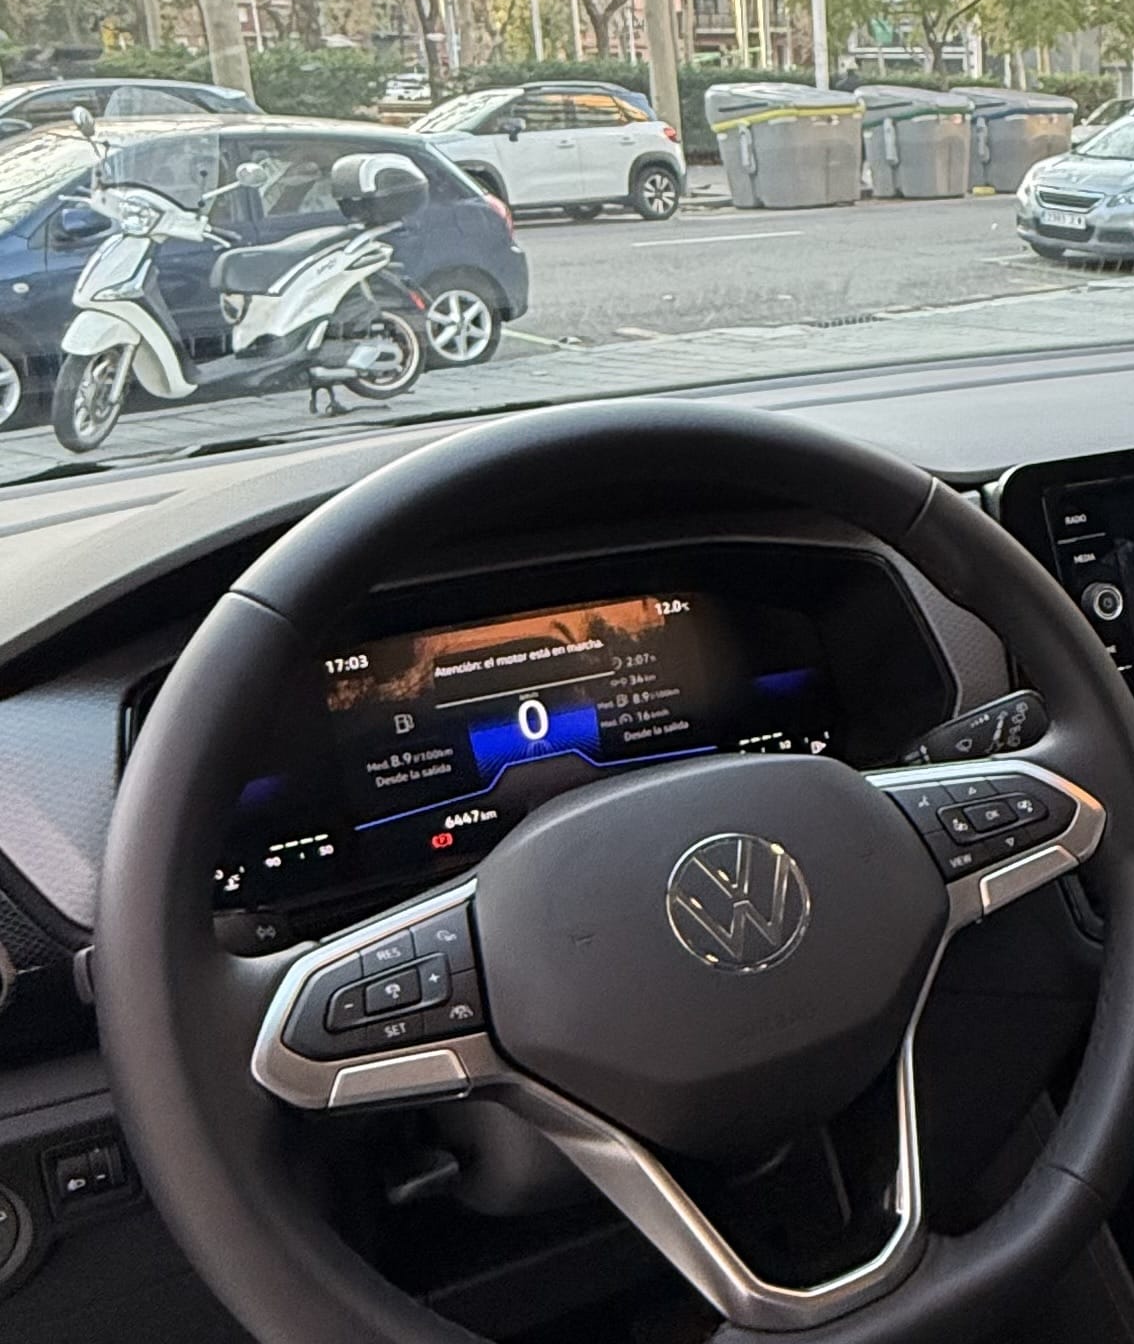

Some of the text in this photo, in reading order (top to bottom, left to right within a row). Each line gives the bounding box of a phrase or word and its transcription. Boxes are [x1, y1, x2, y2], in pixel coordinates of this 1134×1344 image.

[325, 654, 369, 673] 17:03
[434, 660, 482, 677] Atención:
[484, 657, 494, 669] el
[496, 653, 527, 666] motor
[529, 647, 551, 660] está
[551, 646, 565, 656] en
[518, 699, 549, 740] 0
[624, 720, 689, 742] Desde la salida
[390, 752, 412, 768] 8.9
[376, 763, 452, 788] Desde la salida
[445, 809, 479, 829] 6447
[376, 948, 401, 961] RES
[384, 1023, 407, 1038] SET
